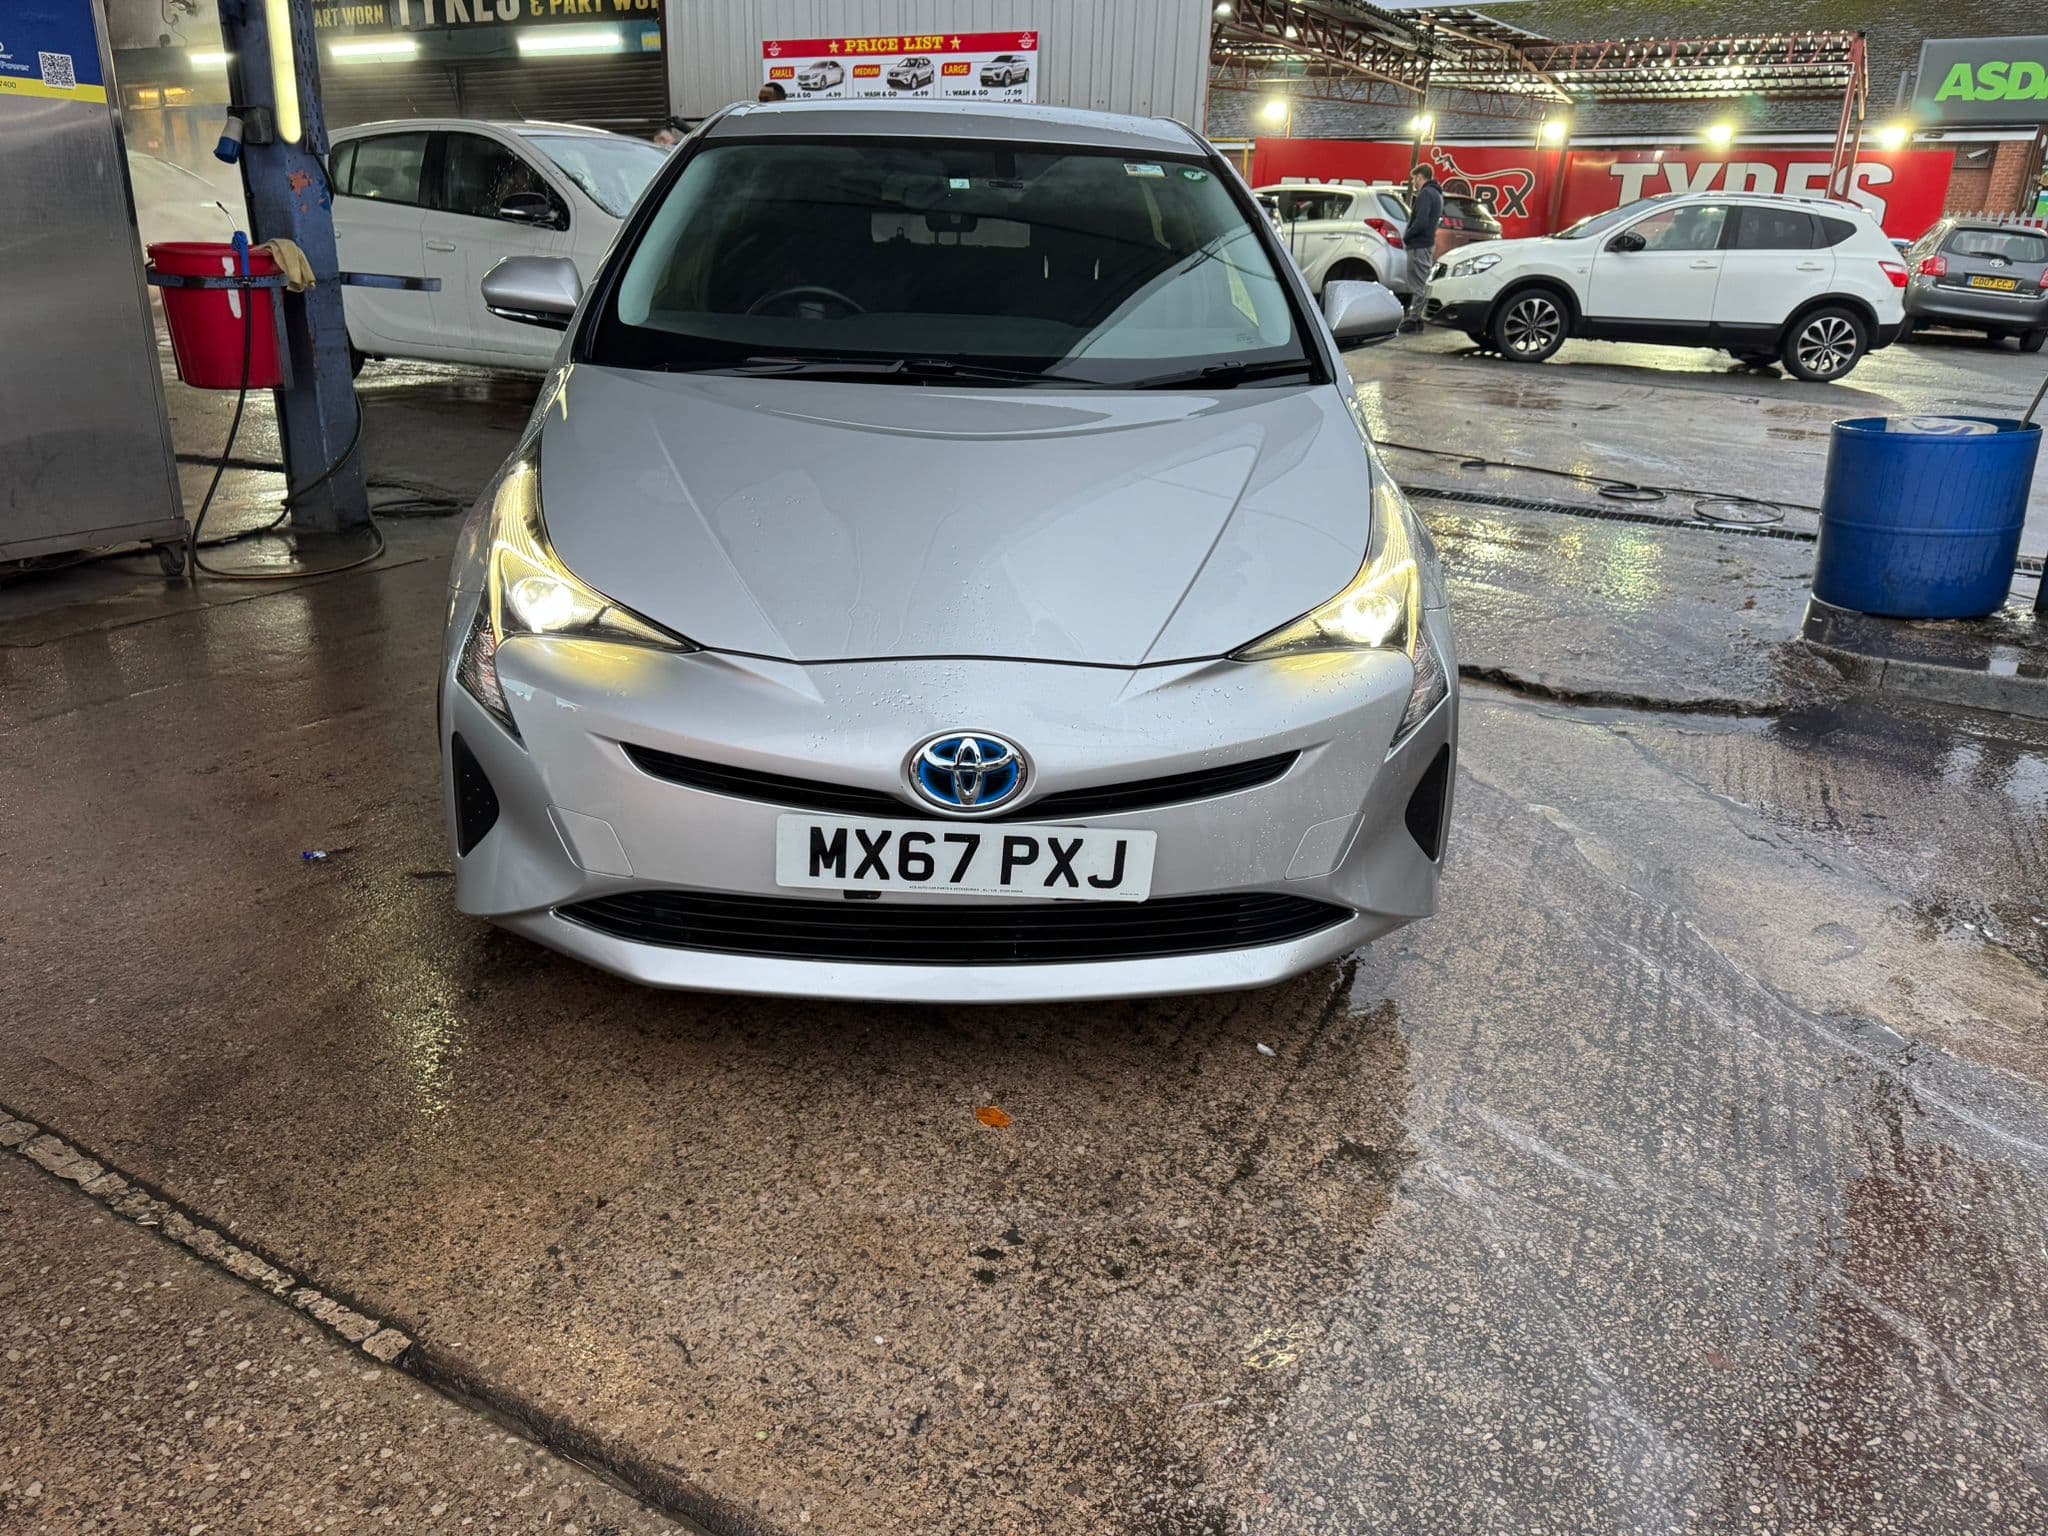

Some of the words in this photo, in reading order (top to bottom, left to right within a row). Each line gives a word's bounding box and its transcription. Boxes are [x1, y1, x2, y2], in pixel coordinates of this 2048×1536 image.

[314, 8, 338, 28] ART
[342, 5, 384, 25] WORN
[844, 39, 899, 53] PRICE
[903, 36, 944, 51] LIST
[771, 69, 793, 79] SMALL
[854, 66, 880, 76] MEDIUM
[943, 64, 969, 74] LARGE
[1935, 61, 2048, 101] ASD
[808, 825, 981, 884] MX67
[998, 834, 1128, 889] PXJ
